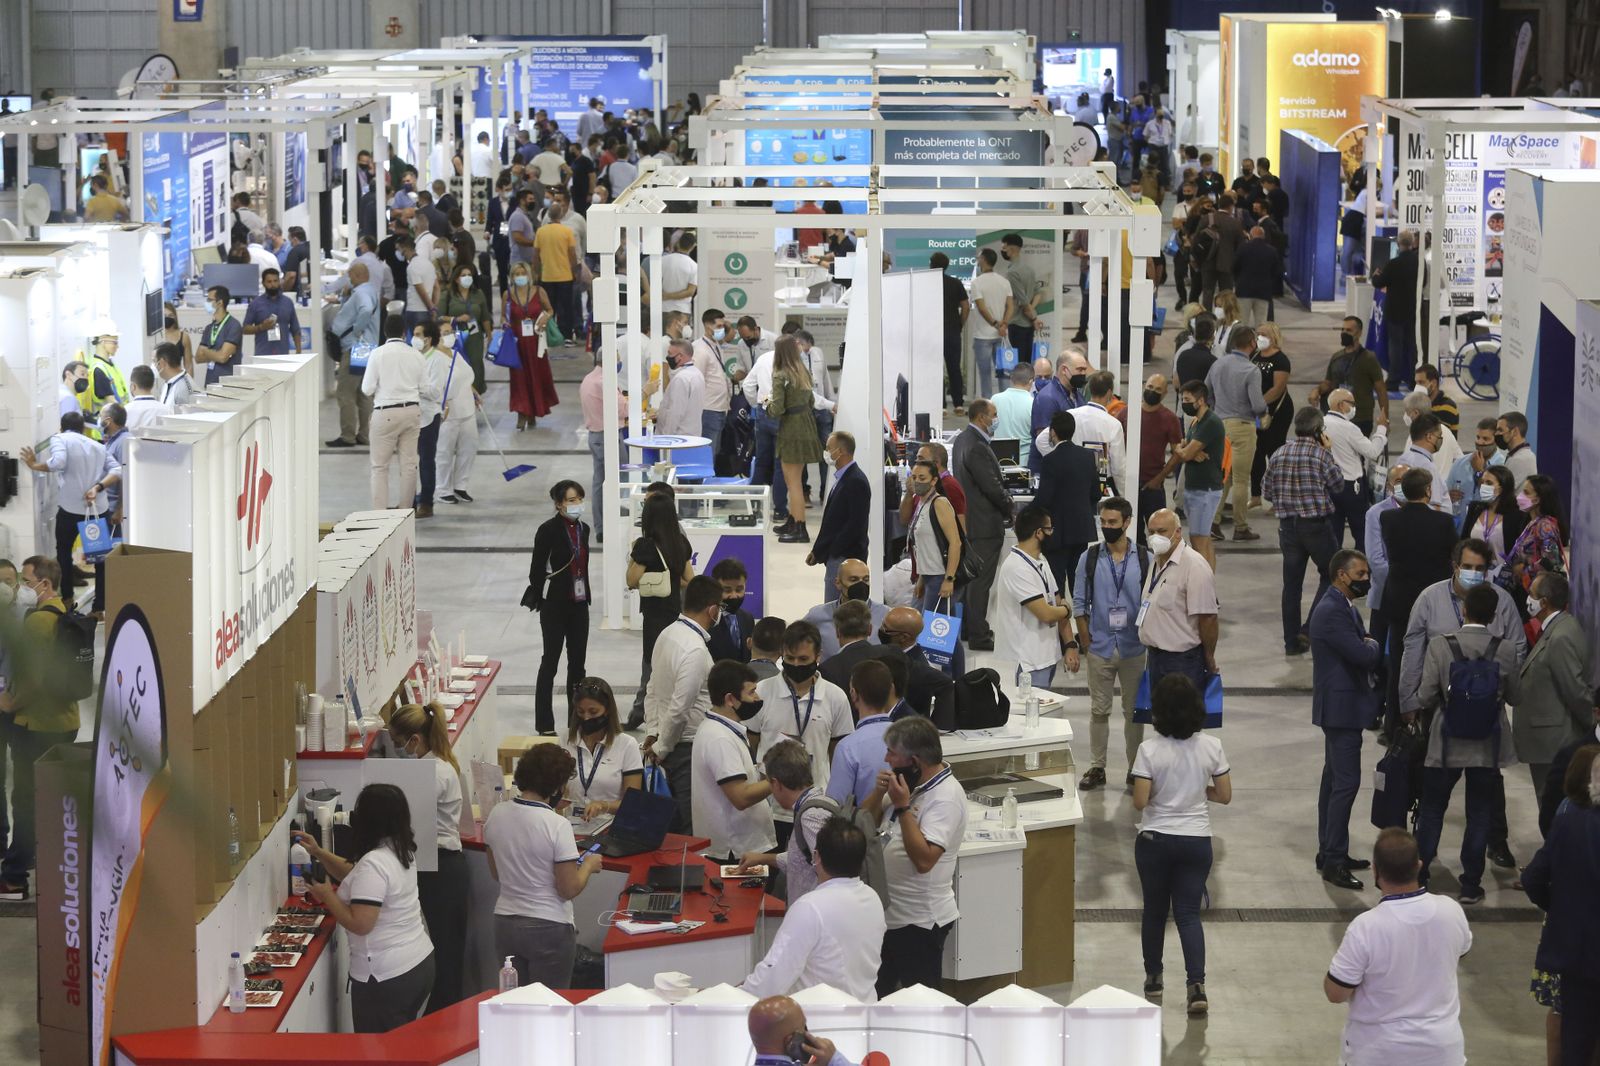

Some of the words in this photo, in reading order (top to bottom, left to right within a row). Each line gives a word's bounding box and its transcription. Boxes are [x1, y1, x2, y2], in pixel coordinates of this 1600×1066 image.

[1293, 49, 1360, 67] adamo
[1280, 96, 1317, 105] Servicio
[1280, 108, 1347, 119] BITSTREAM
[903, 137, 975, 147] Probablemente
[977, 137, 986, 147] la
[988, 138, 1013, 147] ONT
[1408, 133, 1478, 160] MCELL
[894, 151, 914, 160] más
[916, 151, 960, 163] completa
[964, 151, 977, 160] del
[980, 151, 1021, 160] mercado
[928, 239, 957, 248] Router
[215, 557, 295, 671] aleasoluciones
[59, 794, 80, 1007] aleasoluciones
